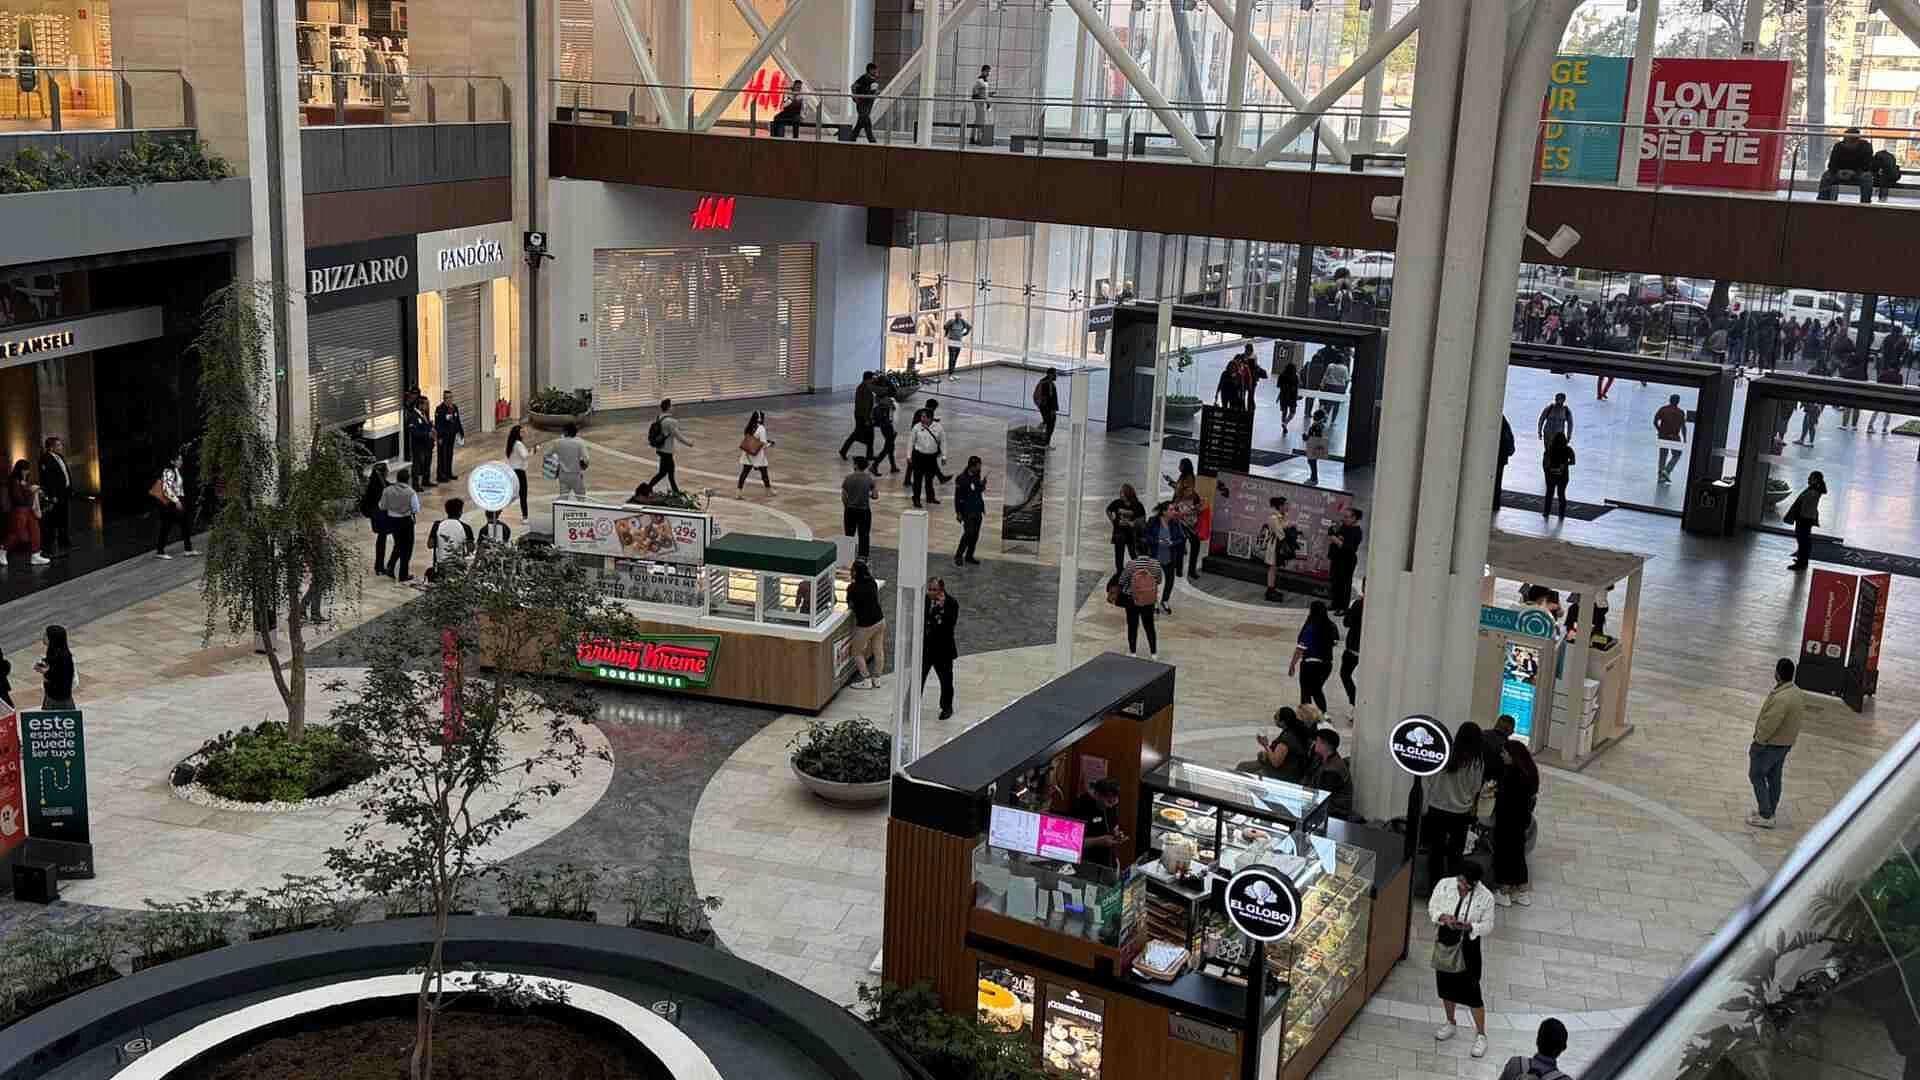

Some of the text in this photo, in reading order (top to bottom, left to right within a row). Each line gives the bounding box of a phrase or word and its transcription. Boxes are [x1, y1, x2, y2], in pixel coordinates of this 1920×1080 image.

[1655, 81, 1752, 110] LOVE
[1653, 107, 1749, 137] YOUR
[1640, 133, 1760, 165] SELFIE
[690, 196, 735, 231] H&M
[439, 239, 504, 272] PANDORA
[310, 255, 409, 295] BIZZARRO
[569, 527, 596, 540] 8+4
[641, 641, 711, 674] Kreme
[599, 668, 683, 688] DOUGHNUTS
[29, 716, 76, 731] este
[30, 729, 76, 741] espacio
[32, 738, 76, 752] puede
[51, 750, 76, 760] tuyo
[1394, 743, 1406, 753] EL
[1407, 746, 1444, 761] GLOBO
[1230, 899, 1245, 911] EL
[1246, 904, 1290, 923] GLOBO
